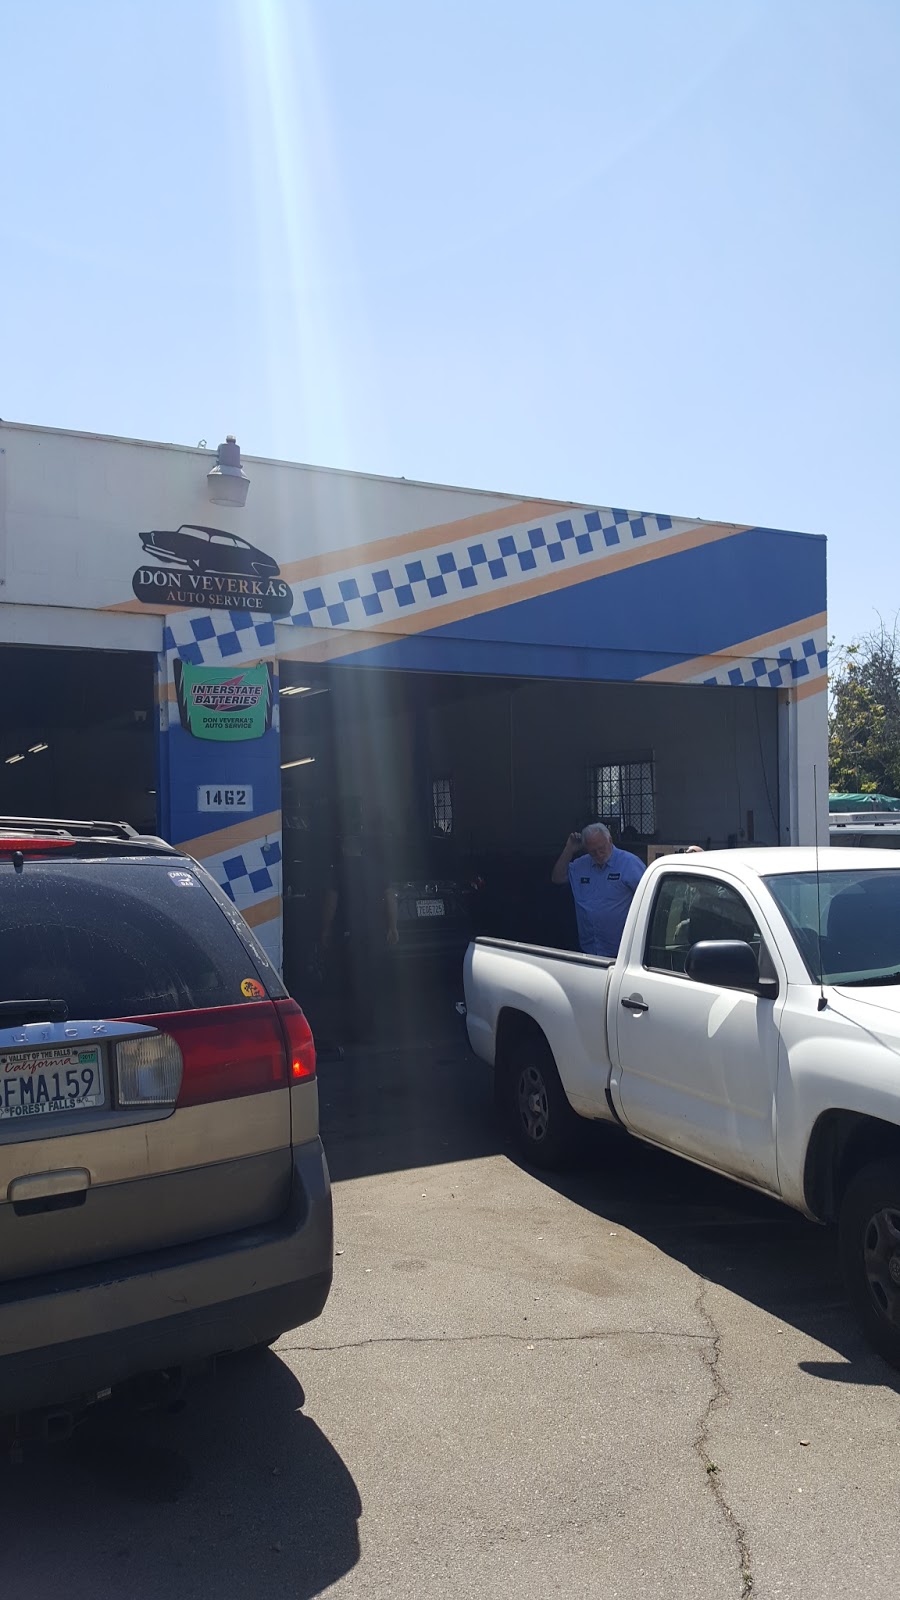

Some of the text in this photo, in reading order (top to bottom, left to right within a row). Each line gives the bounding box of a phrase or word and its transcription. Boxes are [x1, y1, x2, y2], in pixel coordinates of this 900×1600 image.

[139, 569, 182, 588] DON
[167, 590, 263, 609] AUTO SERVICE
[192, 685, 262, 695] INTERSTATE
[195, 695, 258, 705] BATTERIES
[9, 1049, 71, 1062] VALLEY OF THE FALLS
[5, 1057, 77, 1074] California
[10, 1099, 76, 1116] FOREST FALLS
